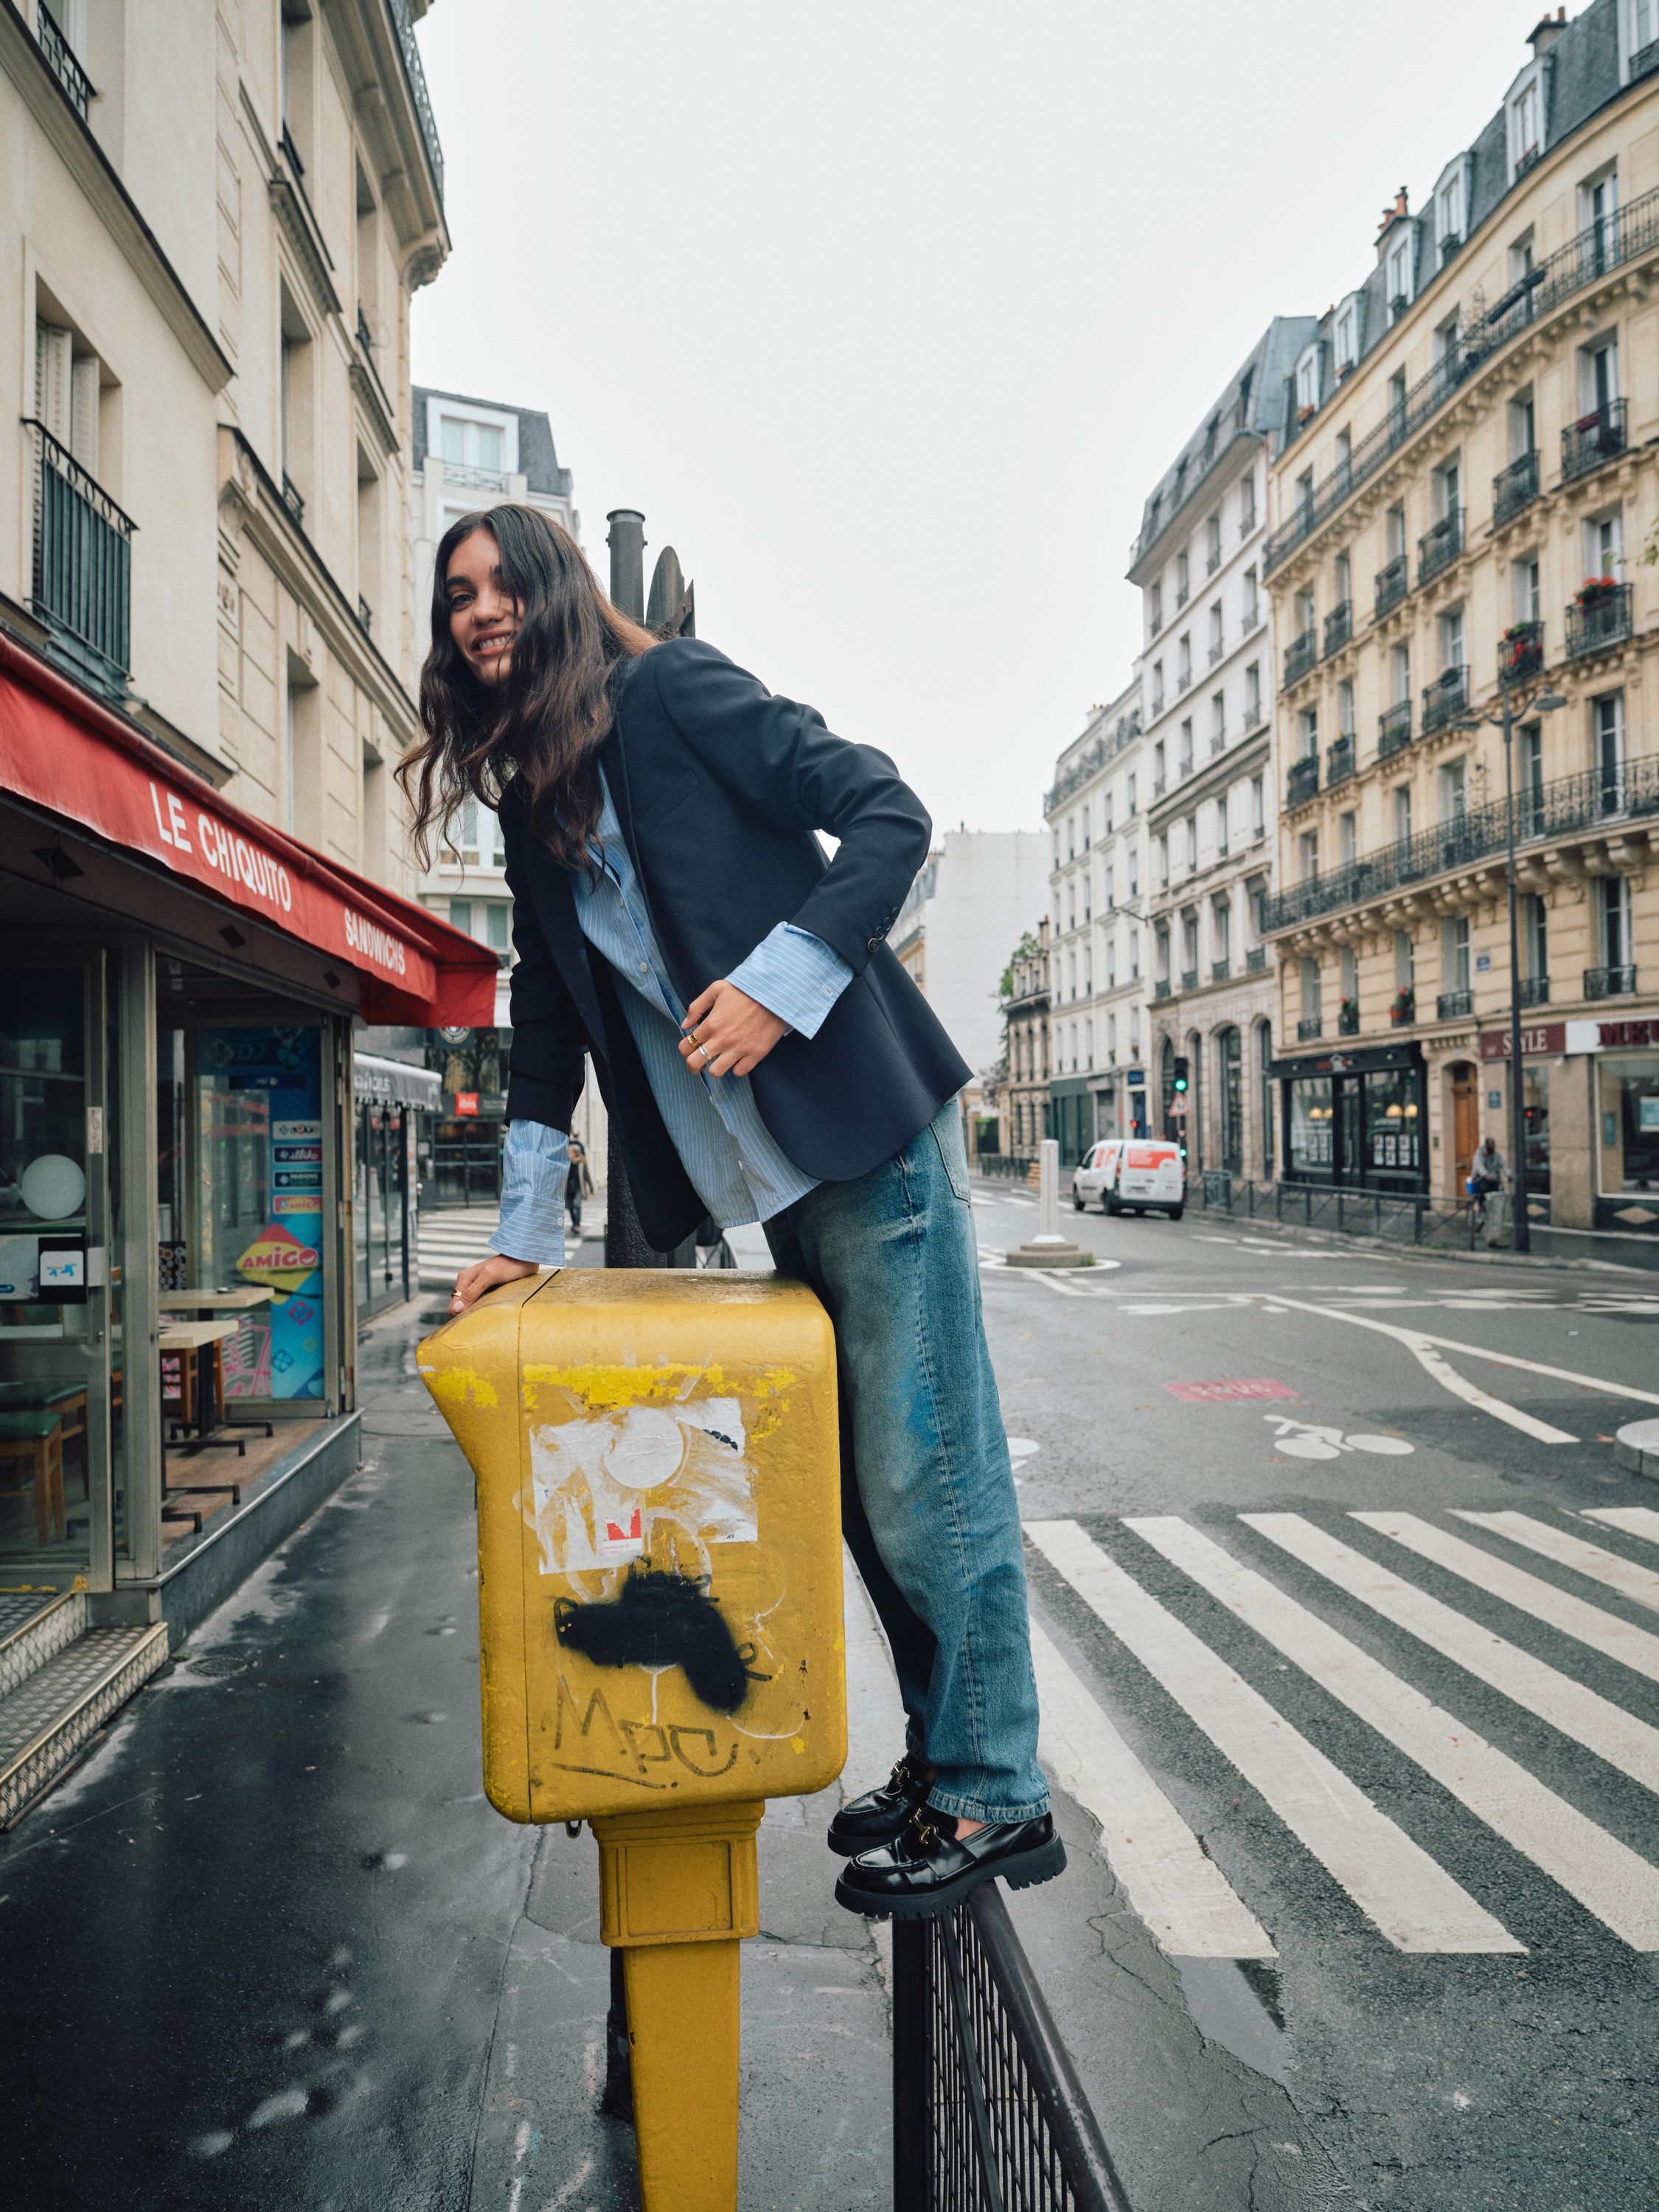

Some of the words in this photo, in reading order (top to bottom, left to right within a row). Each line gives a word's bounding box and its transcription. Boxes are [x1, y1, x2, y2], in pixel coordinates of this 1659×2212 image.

[150, 782, 192, 854] LE
[198, 813, 292, 913] CHIQUITO
[344, 908, 406, 976] SANDWICHS
[1503, 1029, 1548, 1055] SYLE
